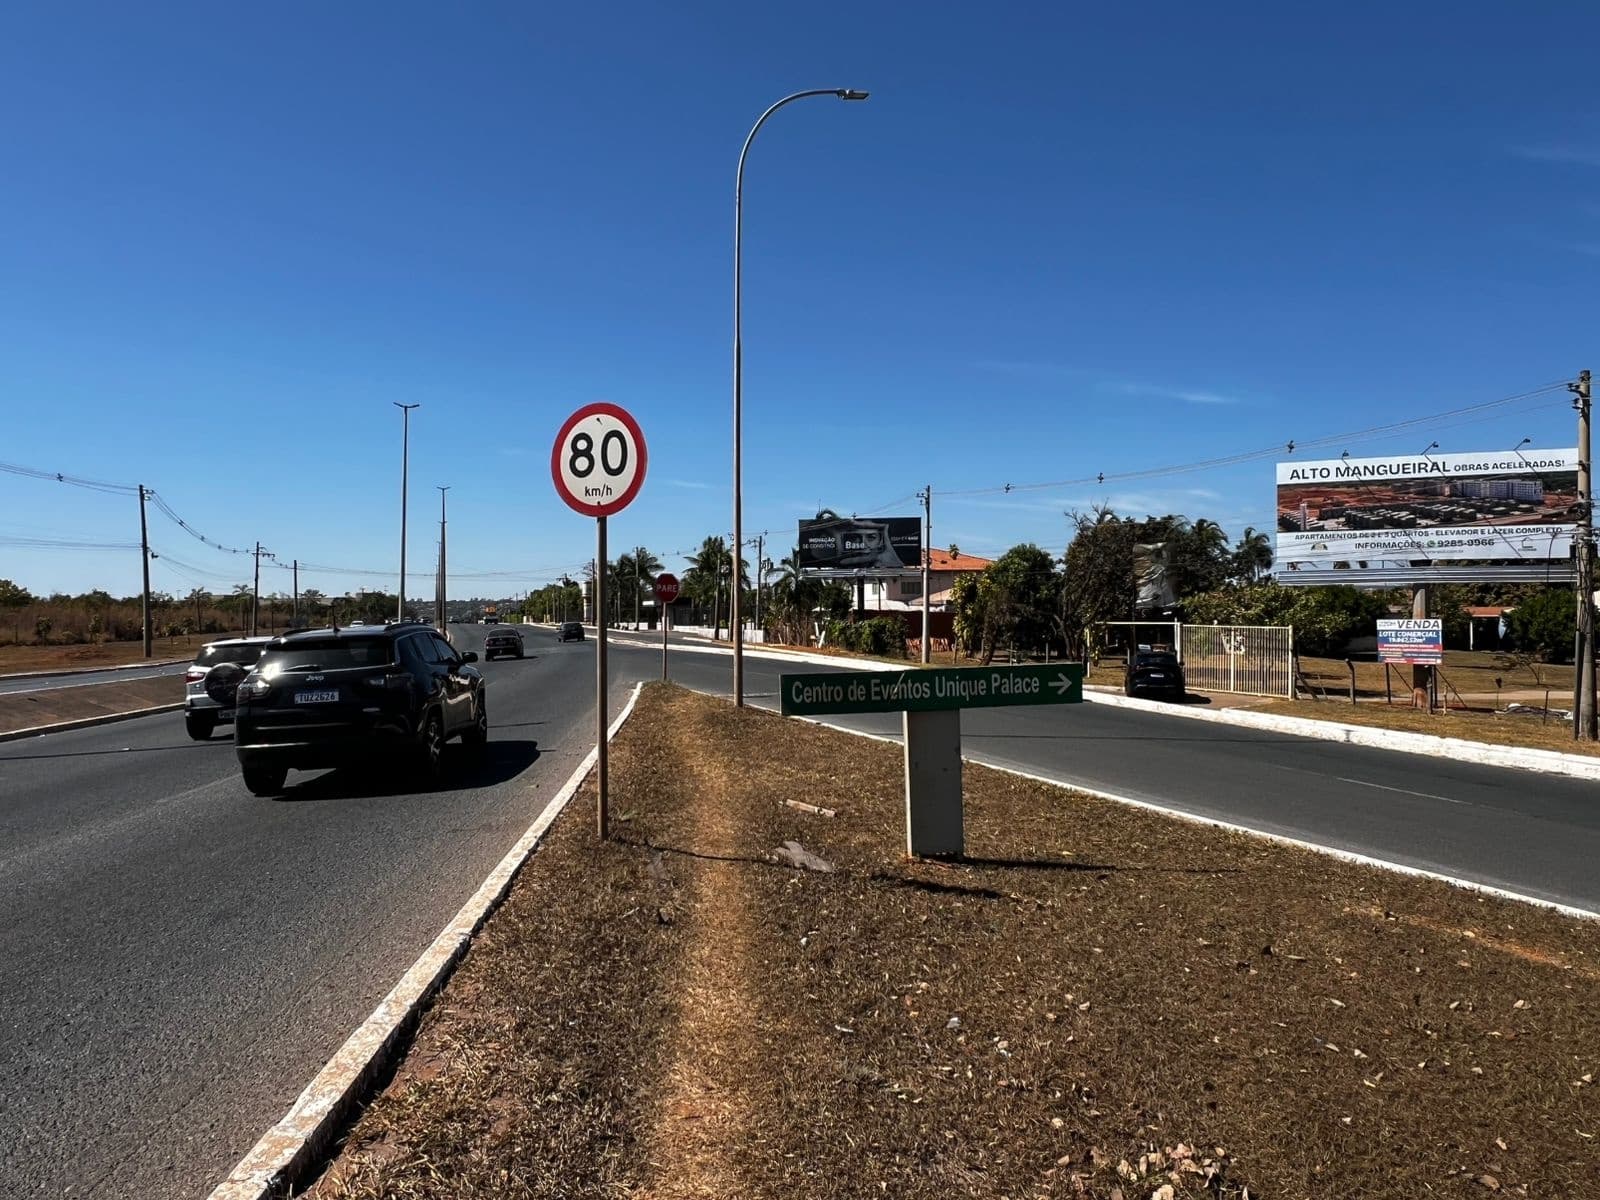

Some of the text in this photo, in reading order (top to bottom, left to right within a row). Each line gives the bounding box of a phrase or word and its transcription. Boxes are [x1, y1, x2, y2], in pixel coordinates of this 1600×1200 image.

[569, 432, 628, 478] 80
[1290, 459, 1565, 480] ALTO MANGUEIRAL OBRAS ACELERADAS!
[584, 483, 613, 498] km/h
[1295, 532, 1357, 540] APARTAMENTOS
[1391, 529, 1429, 538] QUARTOS
[1436, 528, 1479, 536] ELEVADOR
[1488, 527, 1514, 535] LAZER
[656, 584, 678, 593] PARE
[1397, 620, 1440, 629] VENDA
[792, 673, 1040, 703] Centro de Eventos Unique Palace
